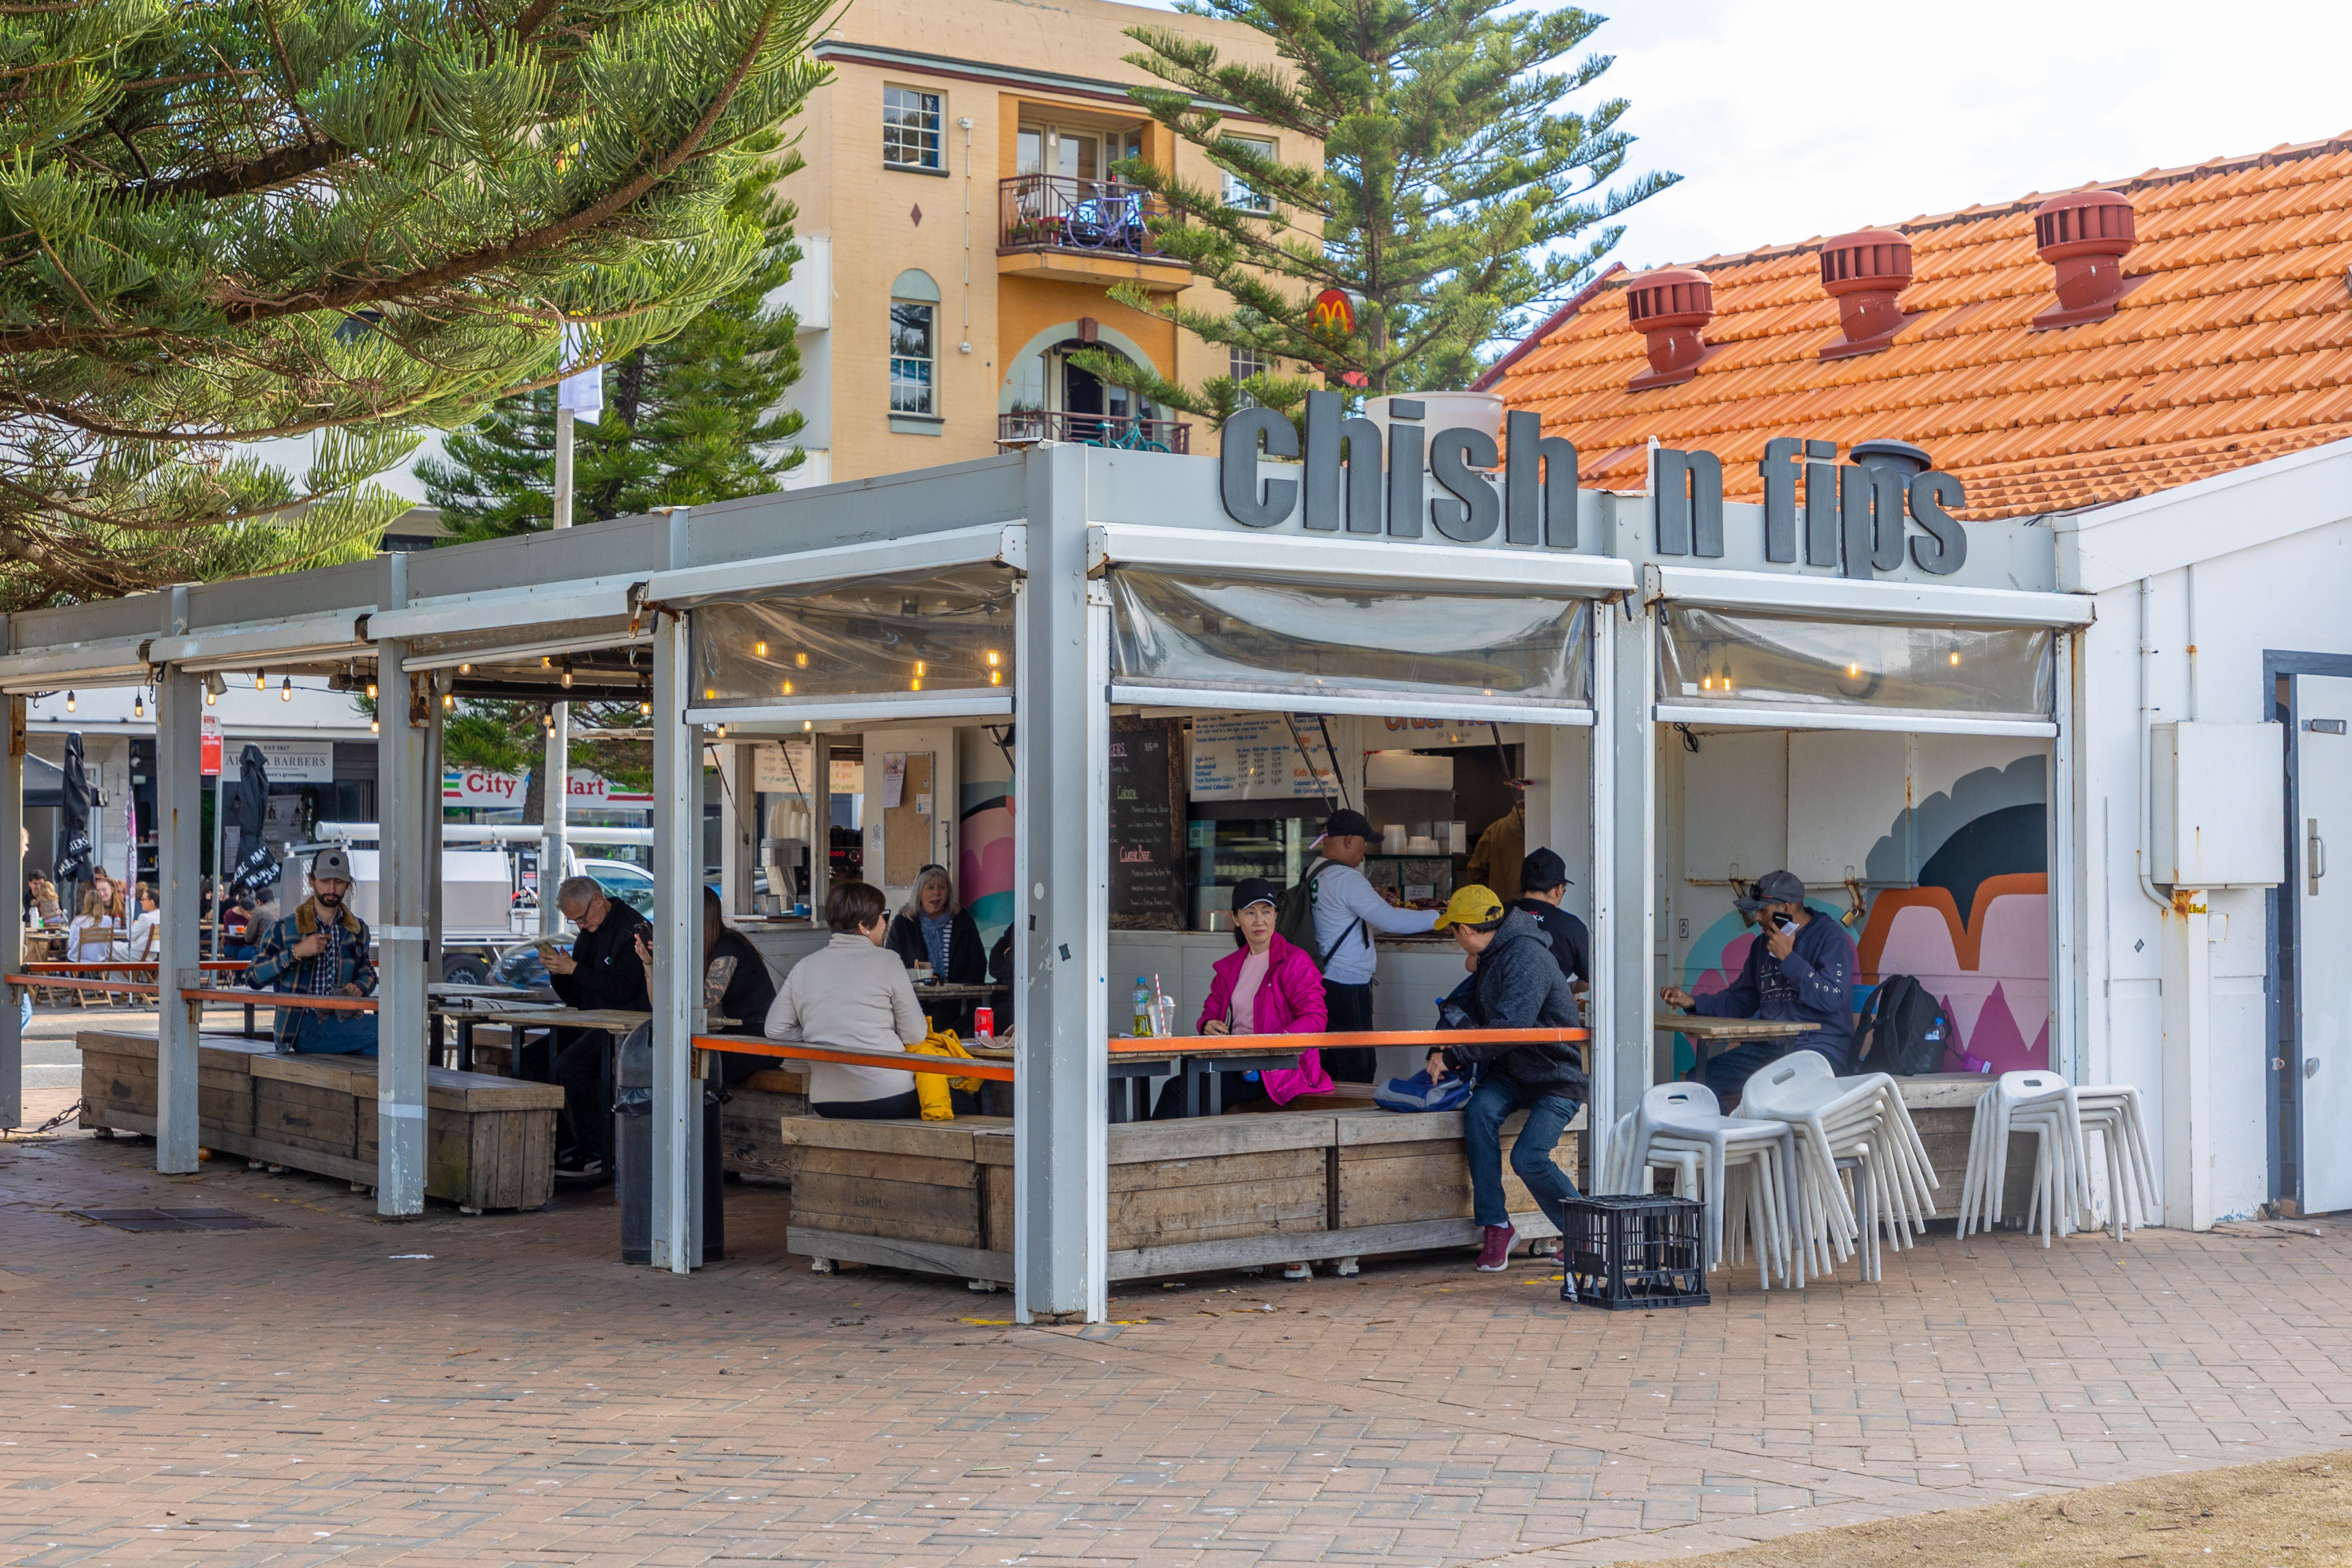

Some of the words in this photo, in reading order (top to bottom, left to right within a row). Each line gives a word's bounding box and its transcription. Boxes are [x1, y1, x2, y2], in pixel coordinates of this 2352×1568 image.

[1654, 448, 1724, 558] n
[1758, 437, 1967, 580] fips
[274, 756, 326, 767] BARBERS
[466, 774, 517, 798] City
